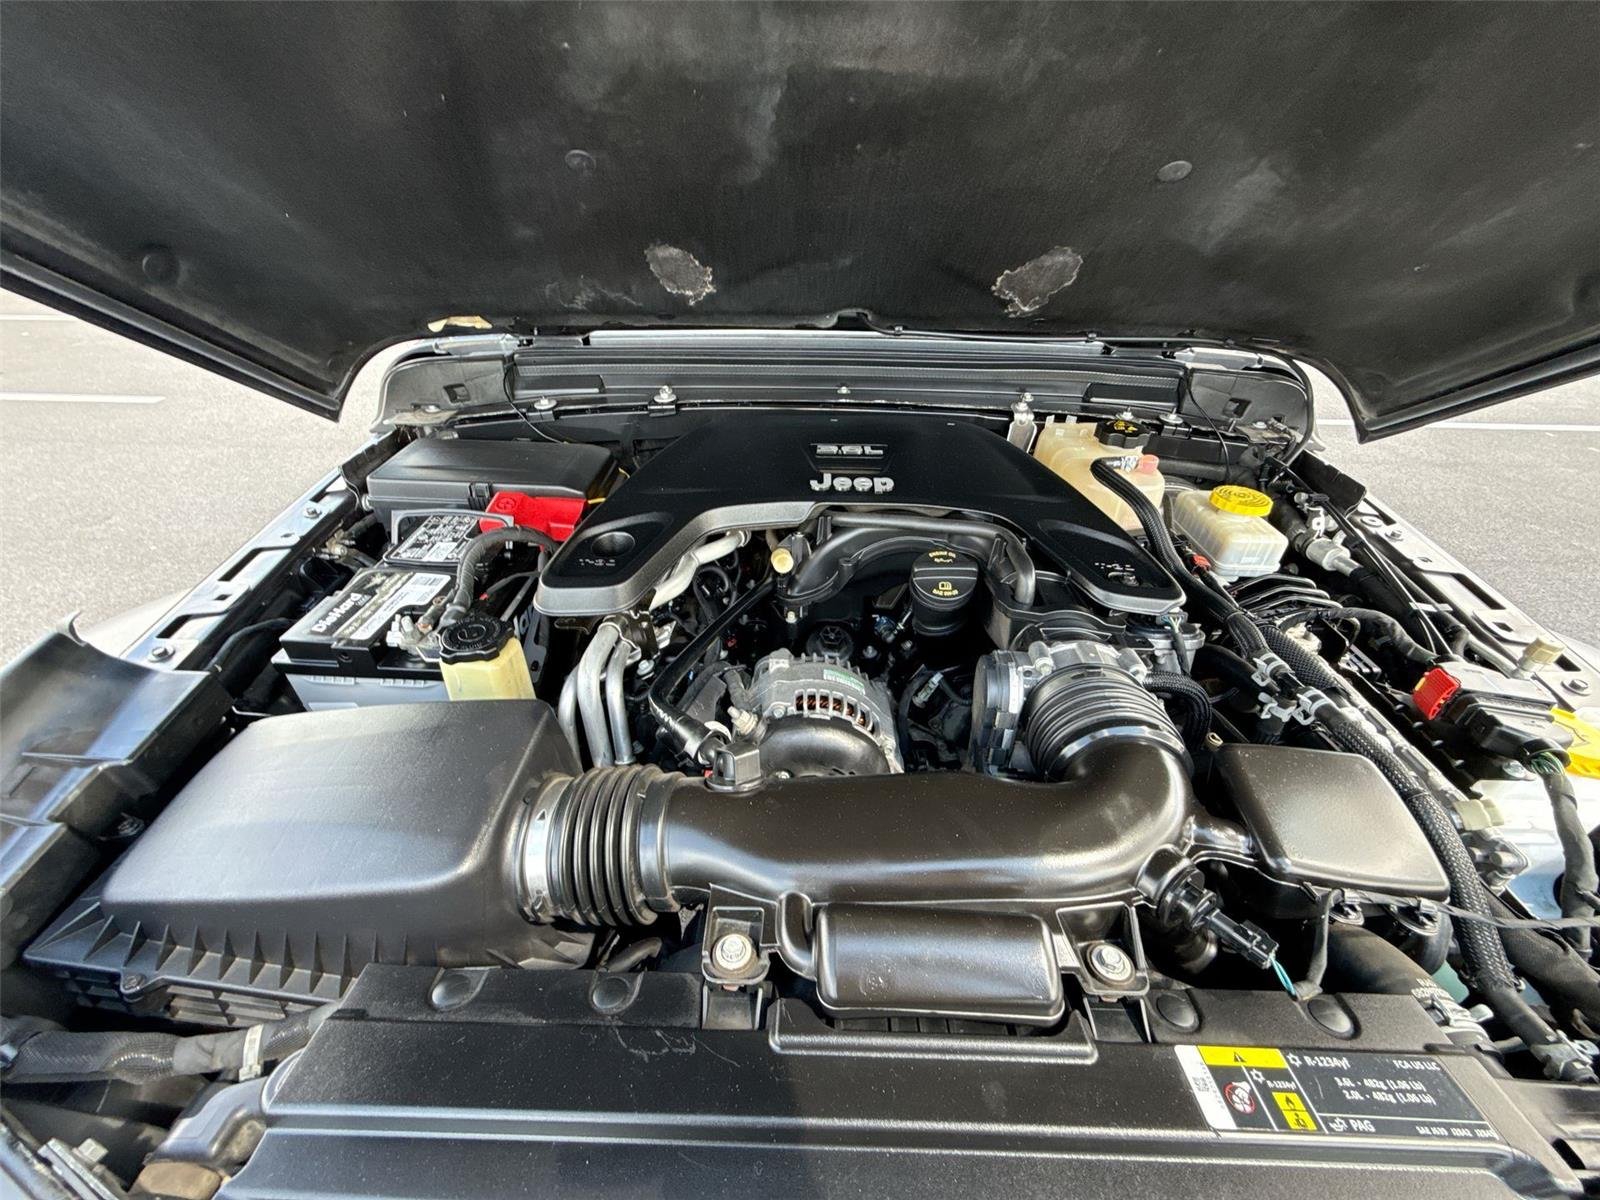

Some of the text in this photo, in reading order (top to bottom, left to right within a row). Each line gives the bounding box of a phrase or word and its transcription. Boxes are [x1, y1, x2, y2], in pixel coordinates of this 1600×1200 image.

[809, 472, 894, 494] Jeep
[311, 592, 362, 633] DieHard
[1304, 1055, 1351, 1071] R-1234yf
[1392, 1059, 1441, 1071] FCA US LLC
[1349, 1119, 1377, 1133] PAG
